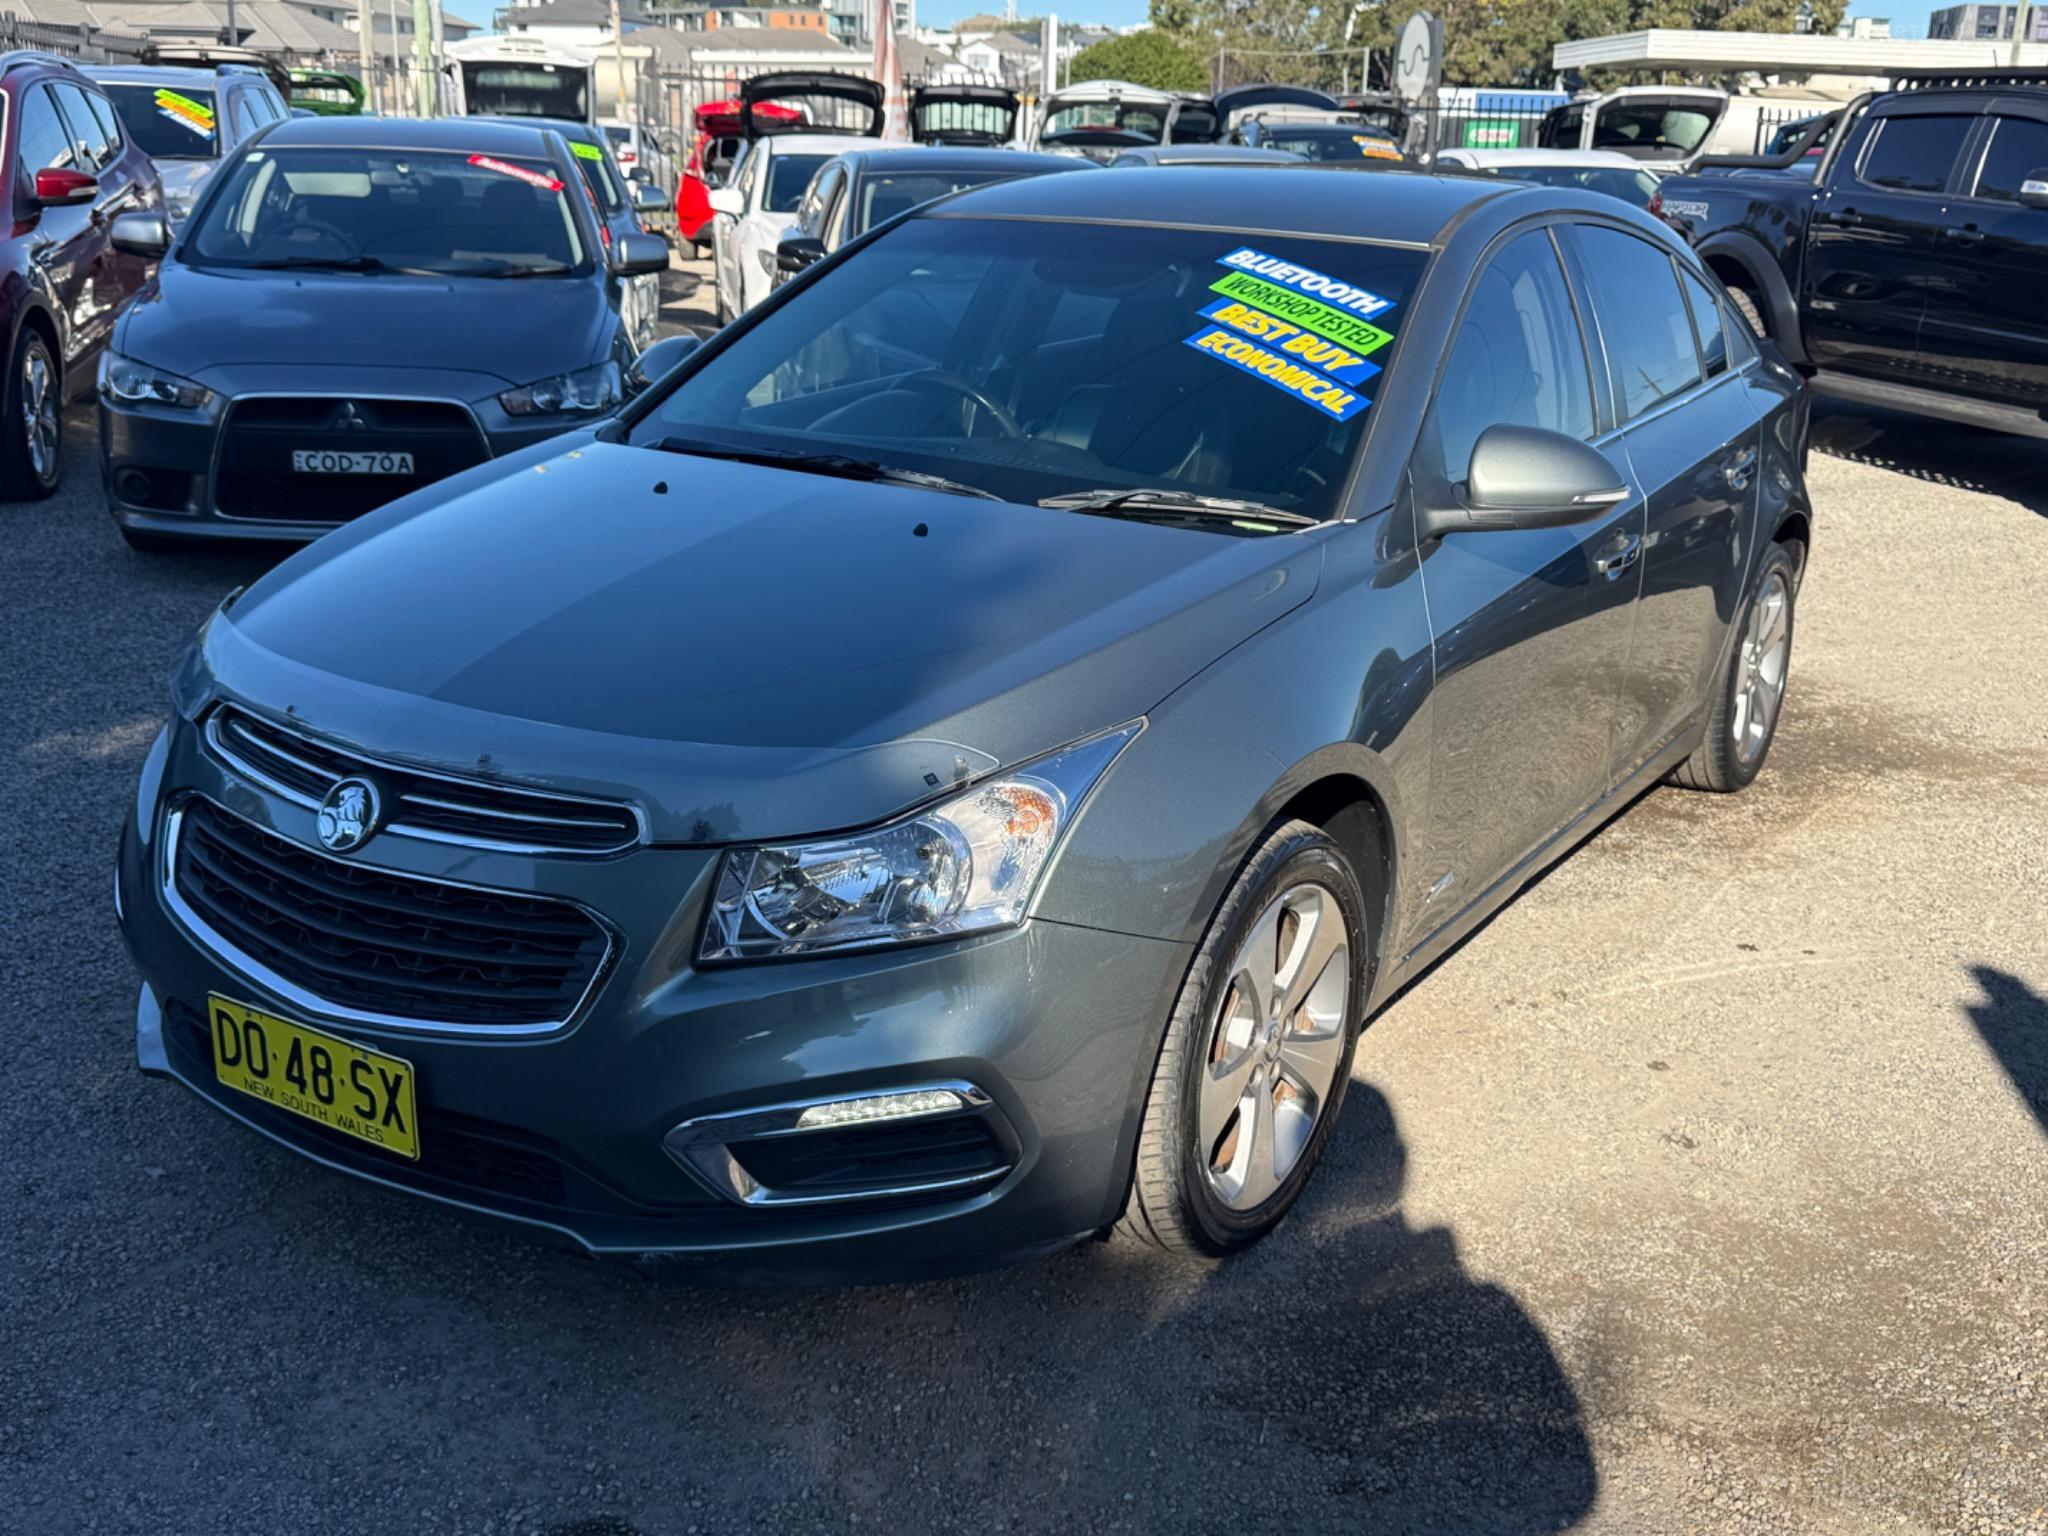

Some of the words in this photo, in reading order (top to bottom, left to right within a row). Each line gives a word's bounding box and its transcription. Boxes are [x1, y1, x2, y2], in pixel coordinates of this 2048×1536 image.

[1223, 249, 1389, 314] BLUETOOTH
[1224, 276, 1321, 319] WORKSHOP
[1311, 310, 1379, 347] TESTED
[1211, 303, 1301, 342] BEST
[1281, 333, 1365, 372] BUY
[1196, 330, 1357, 415] ECONOMICAL
[243, 1076, 275, 1098] NEW
[280, 1090, 329, 1122] SOUTH
[335, 1110, 385, 1143] WALES
